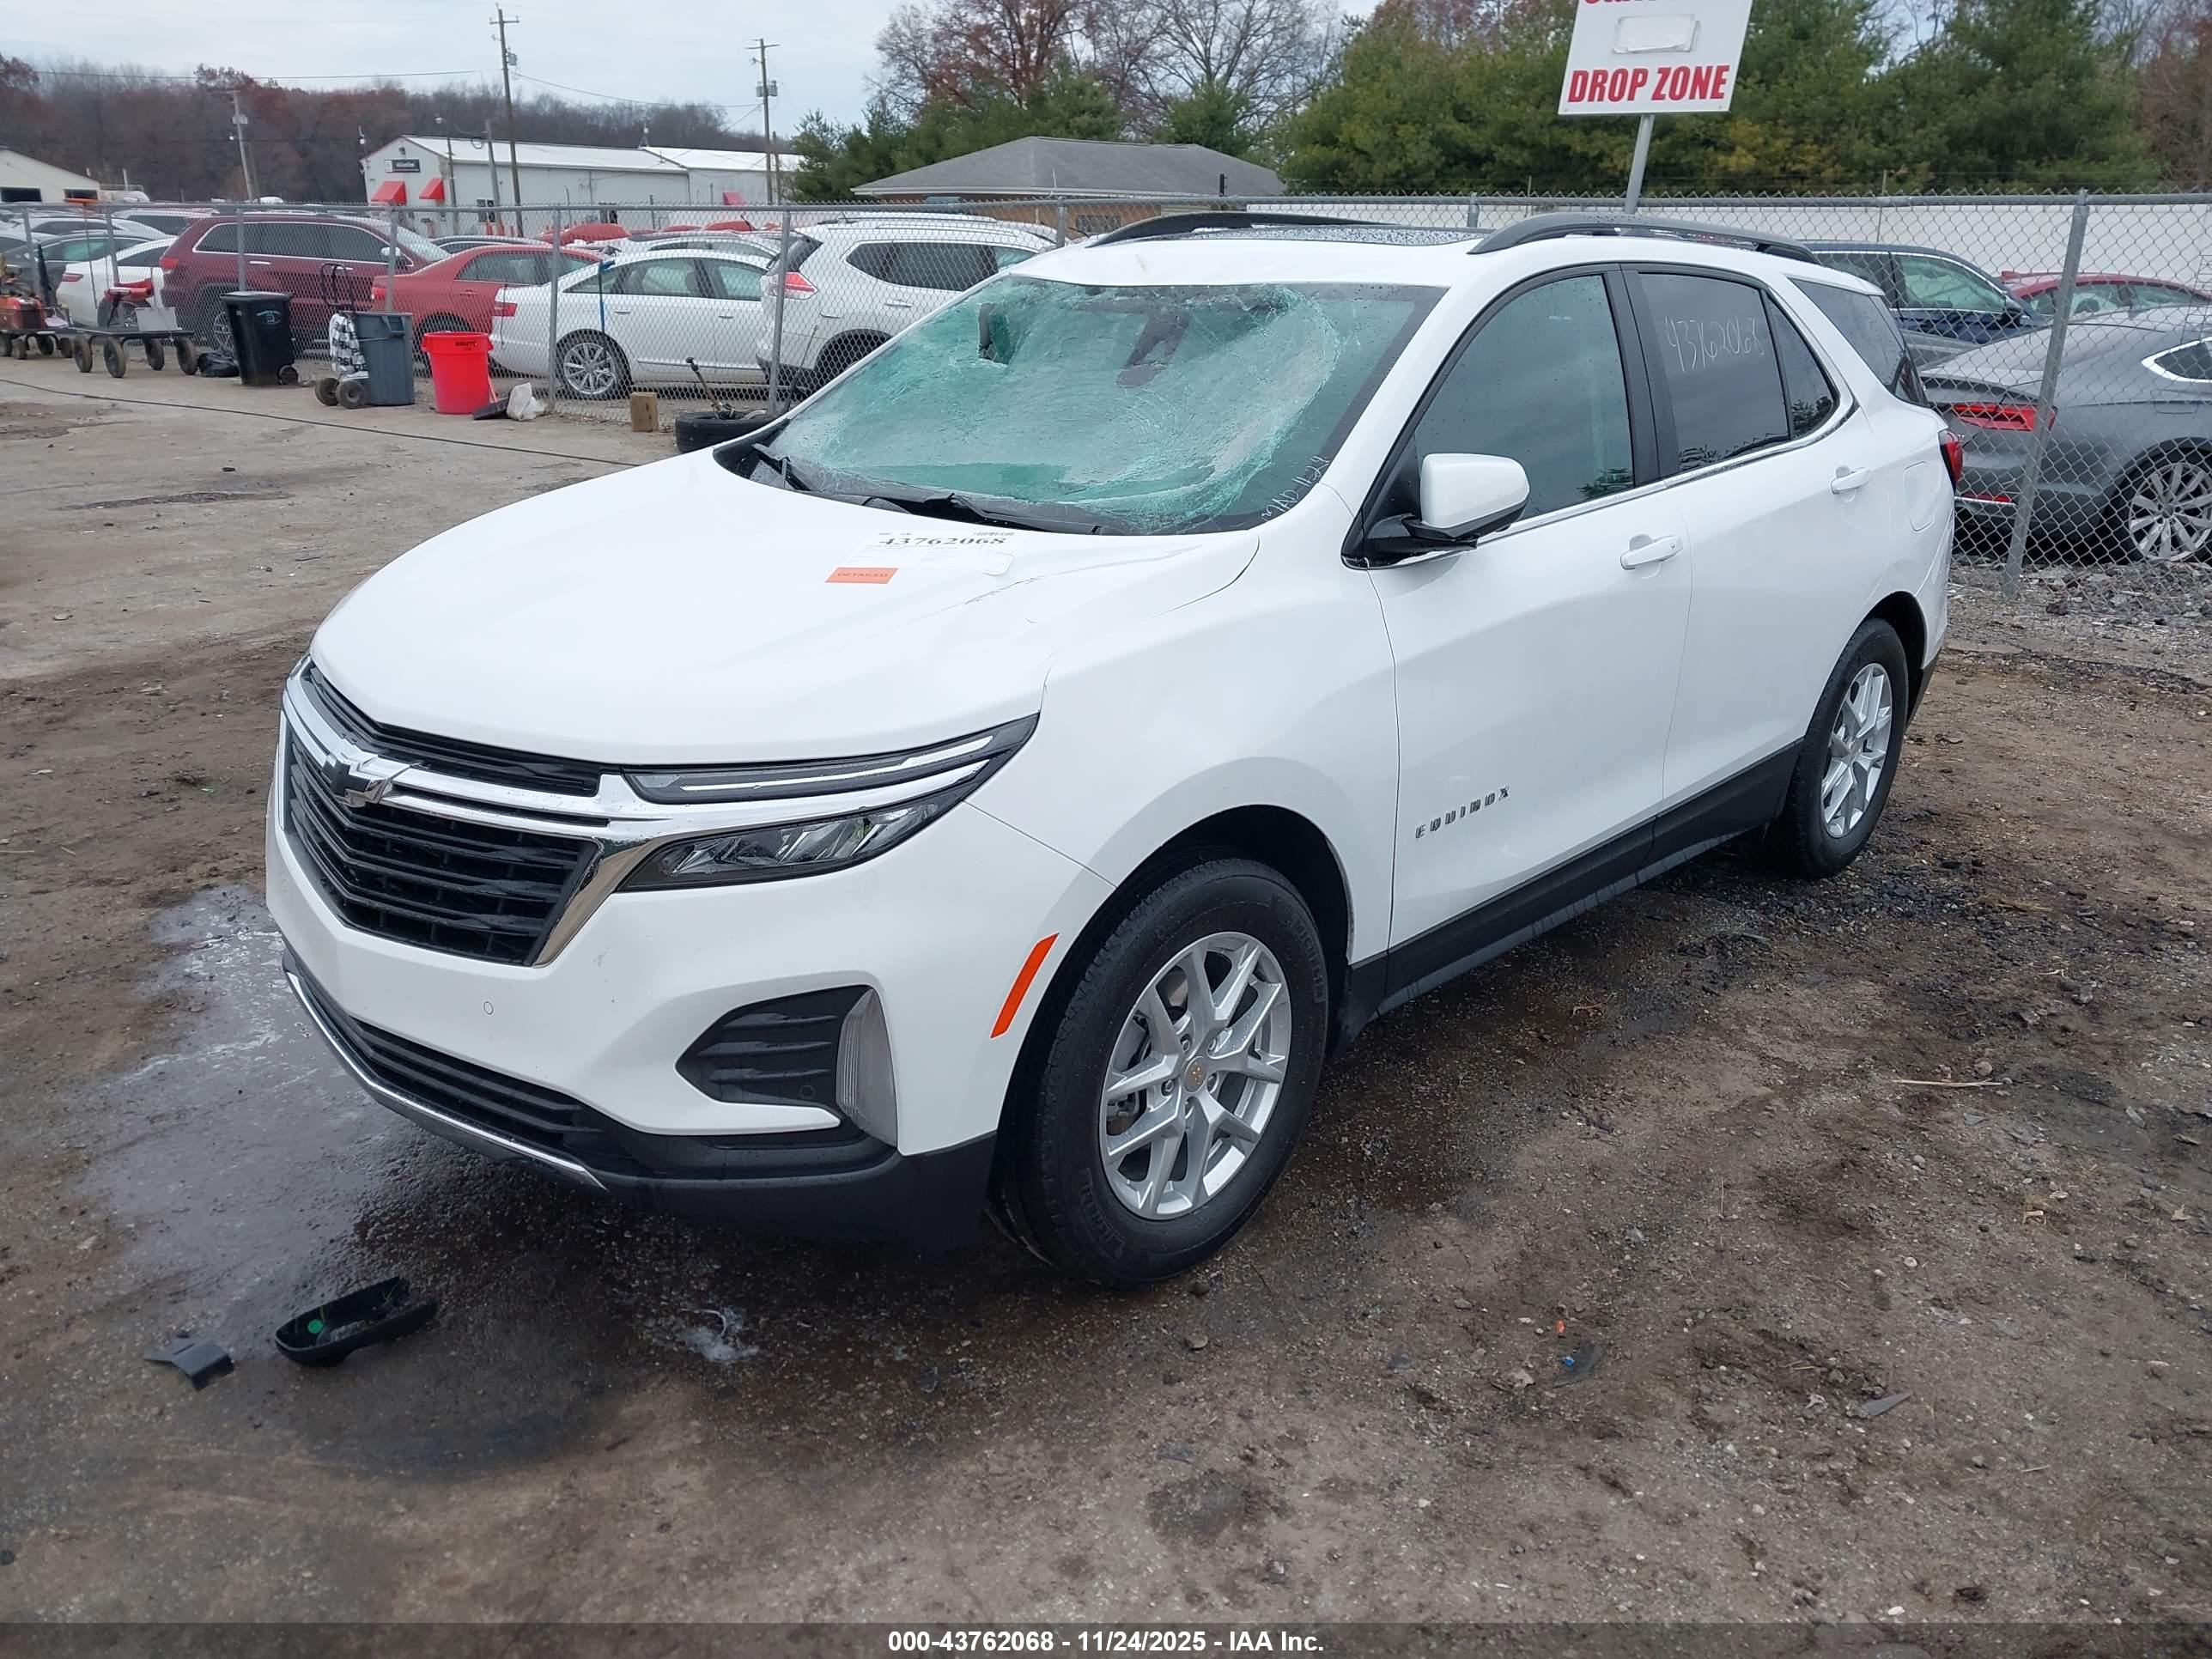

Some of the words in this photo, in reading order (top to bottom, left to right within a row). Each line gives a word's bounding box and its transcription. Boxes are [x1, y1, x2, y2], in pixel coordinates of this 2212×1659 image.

[1567, 68, 1649, 103] DROP
[1651, 64, 1730, 100] ZONE
[878, 537, 1007, 545] 43762068
[1415, 785, 1510, 839] EQUINOX
